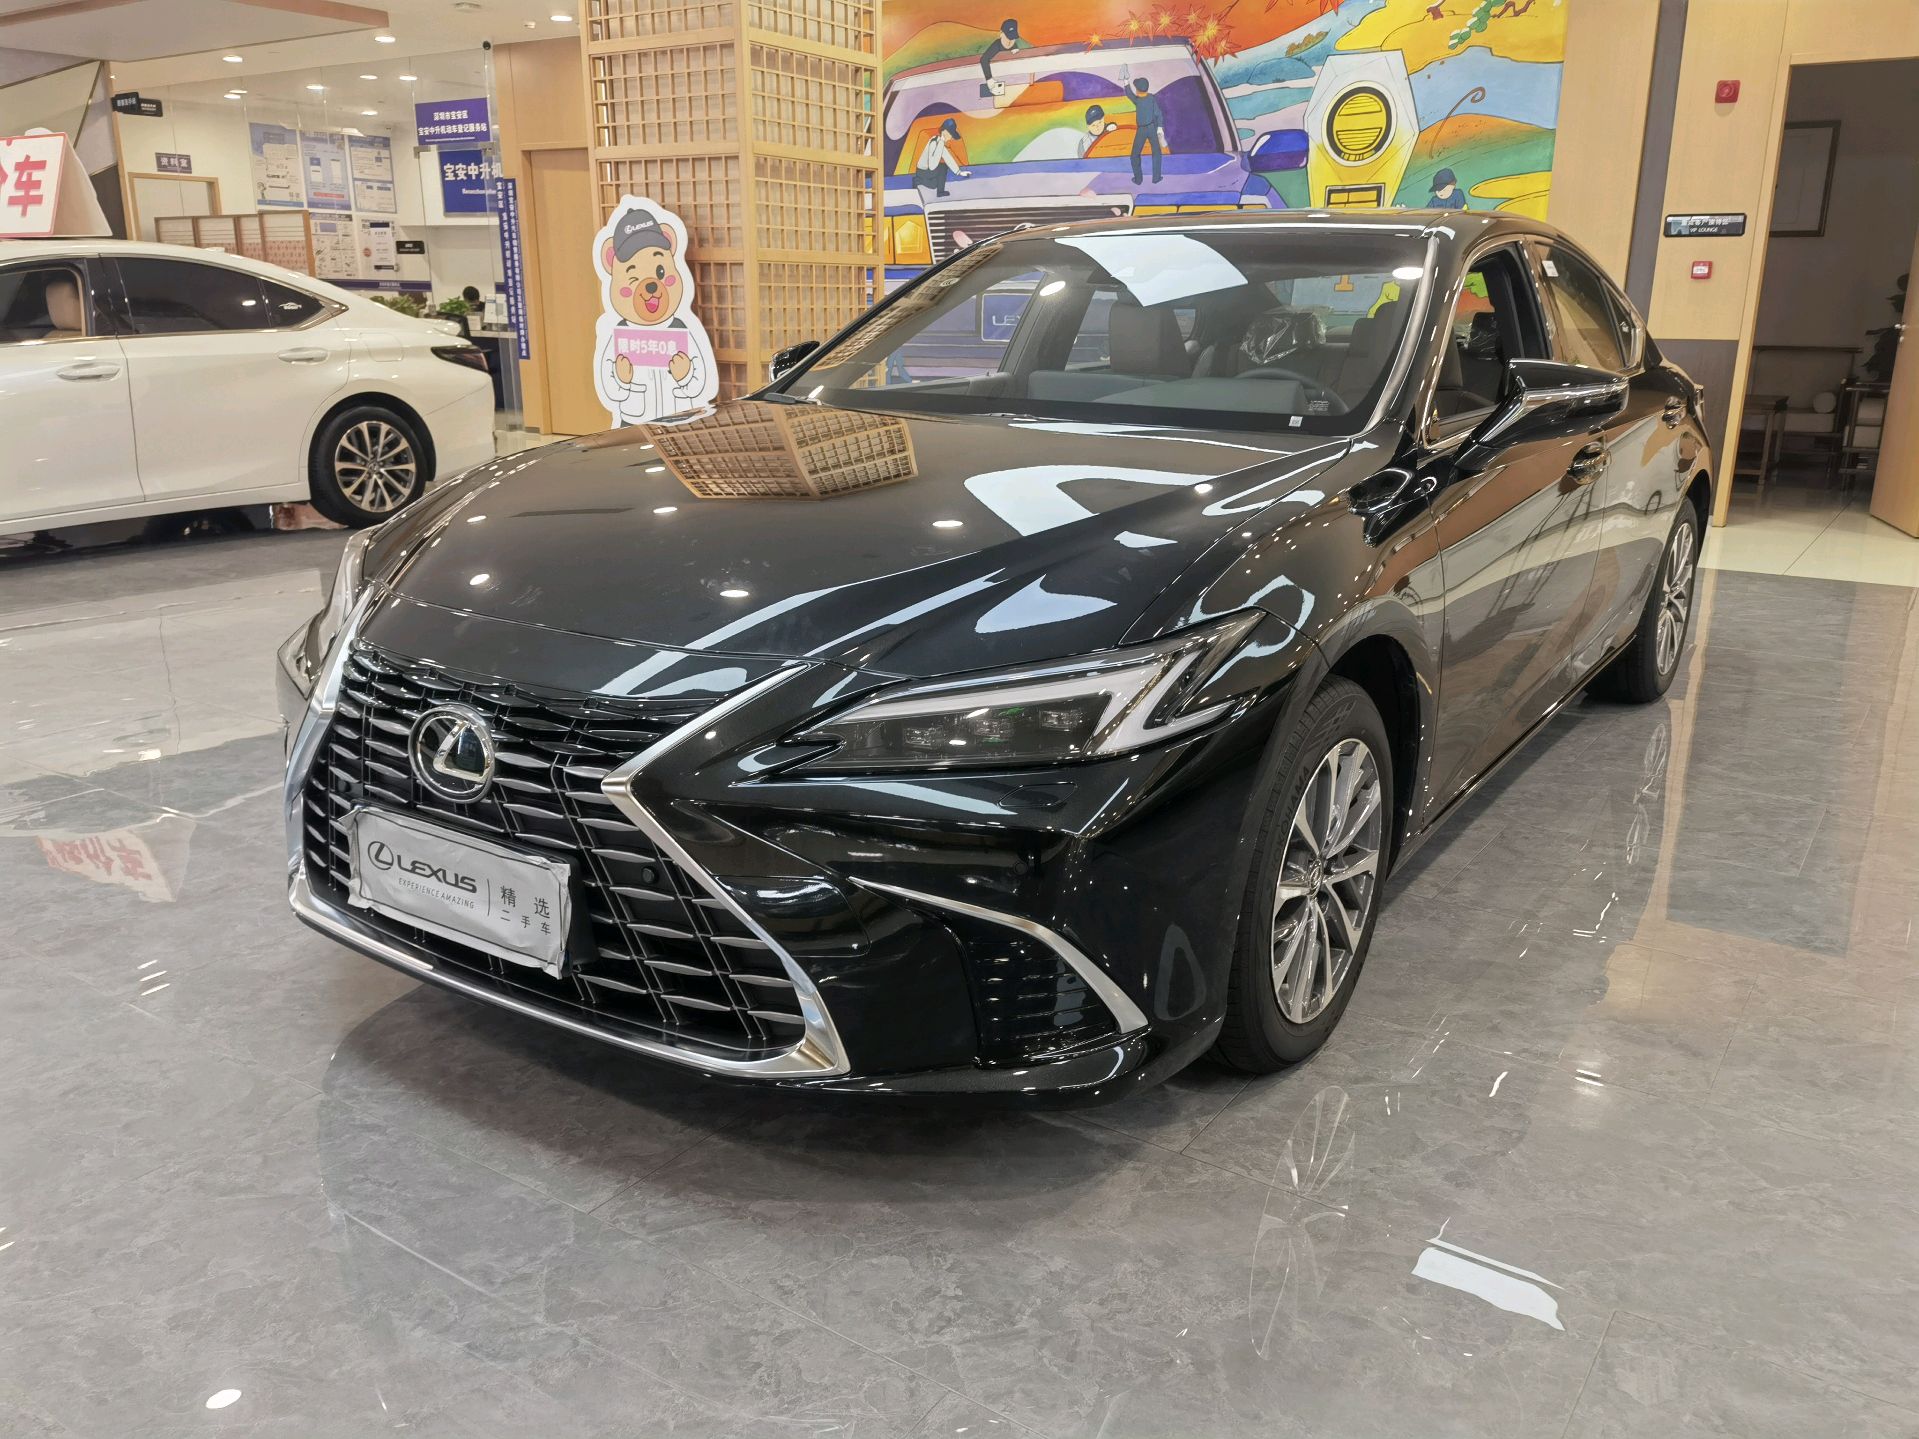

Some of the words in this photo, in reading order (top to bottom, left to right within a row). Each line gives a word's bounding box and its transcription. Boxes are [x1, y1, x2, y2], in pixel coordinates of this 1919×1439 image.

[0, 154, 47, 218] 车
[396, 854, 478, 894] LEXUS
[398, 877, 440, 899] EXPERIENCE
[440, 892, 475, 909] AMAZING
[500, 885, 551, 919] 精选
[500, 909, 551, 936] 二手车
